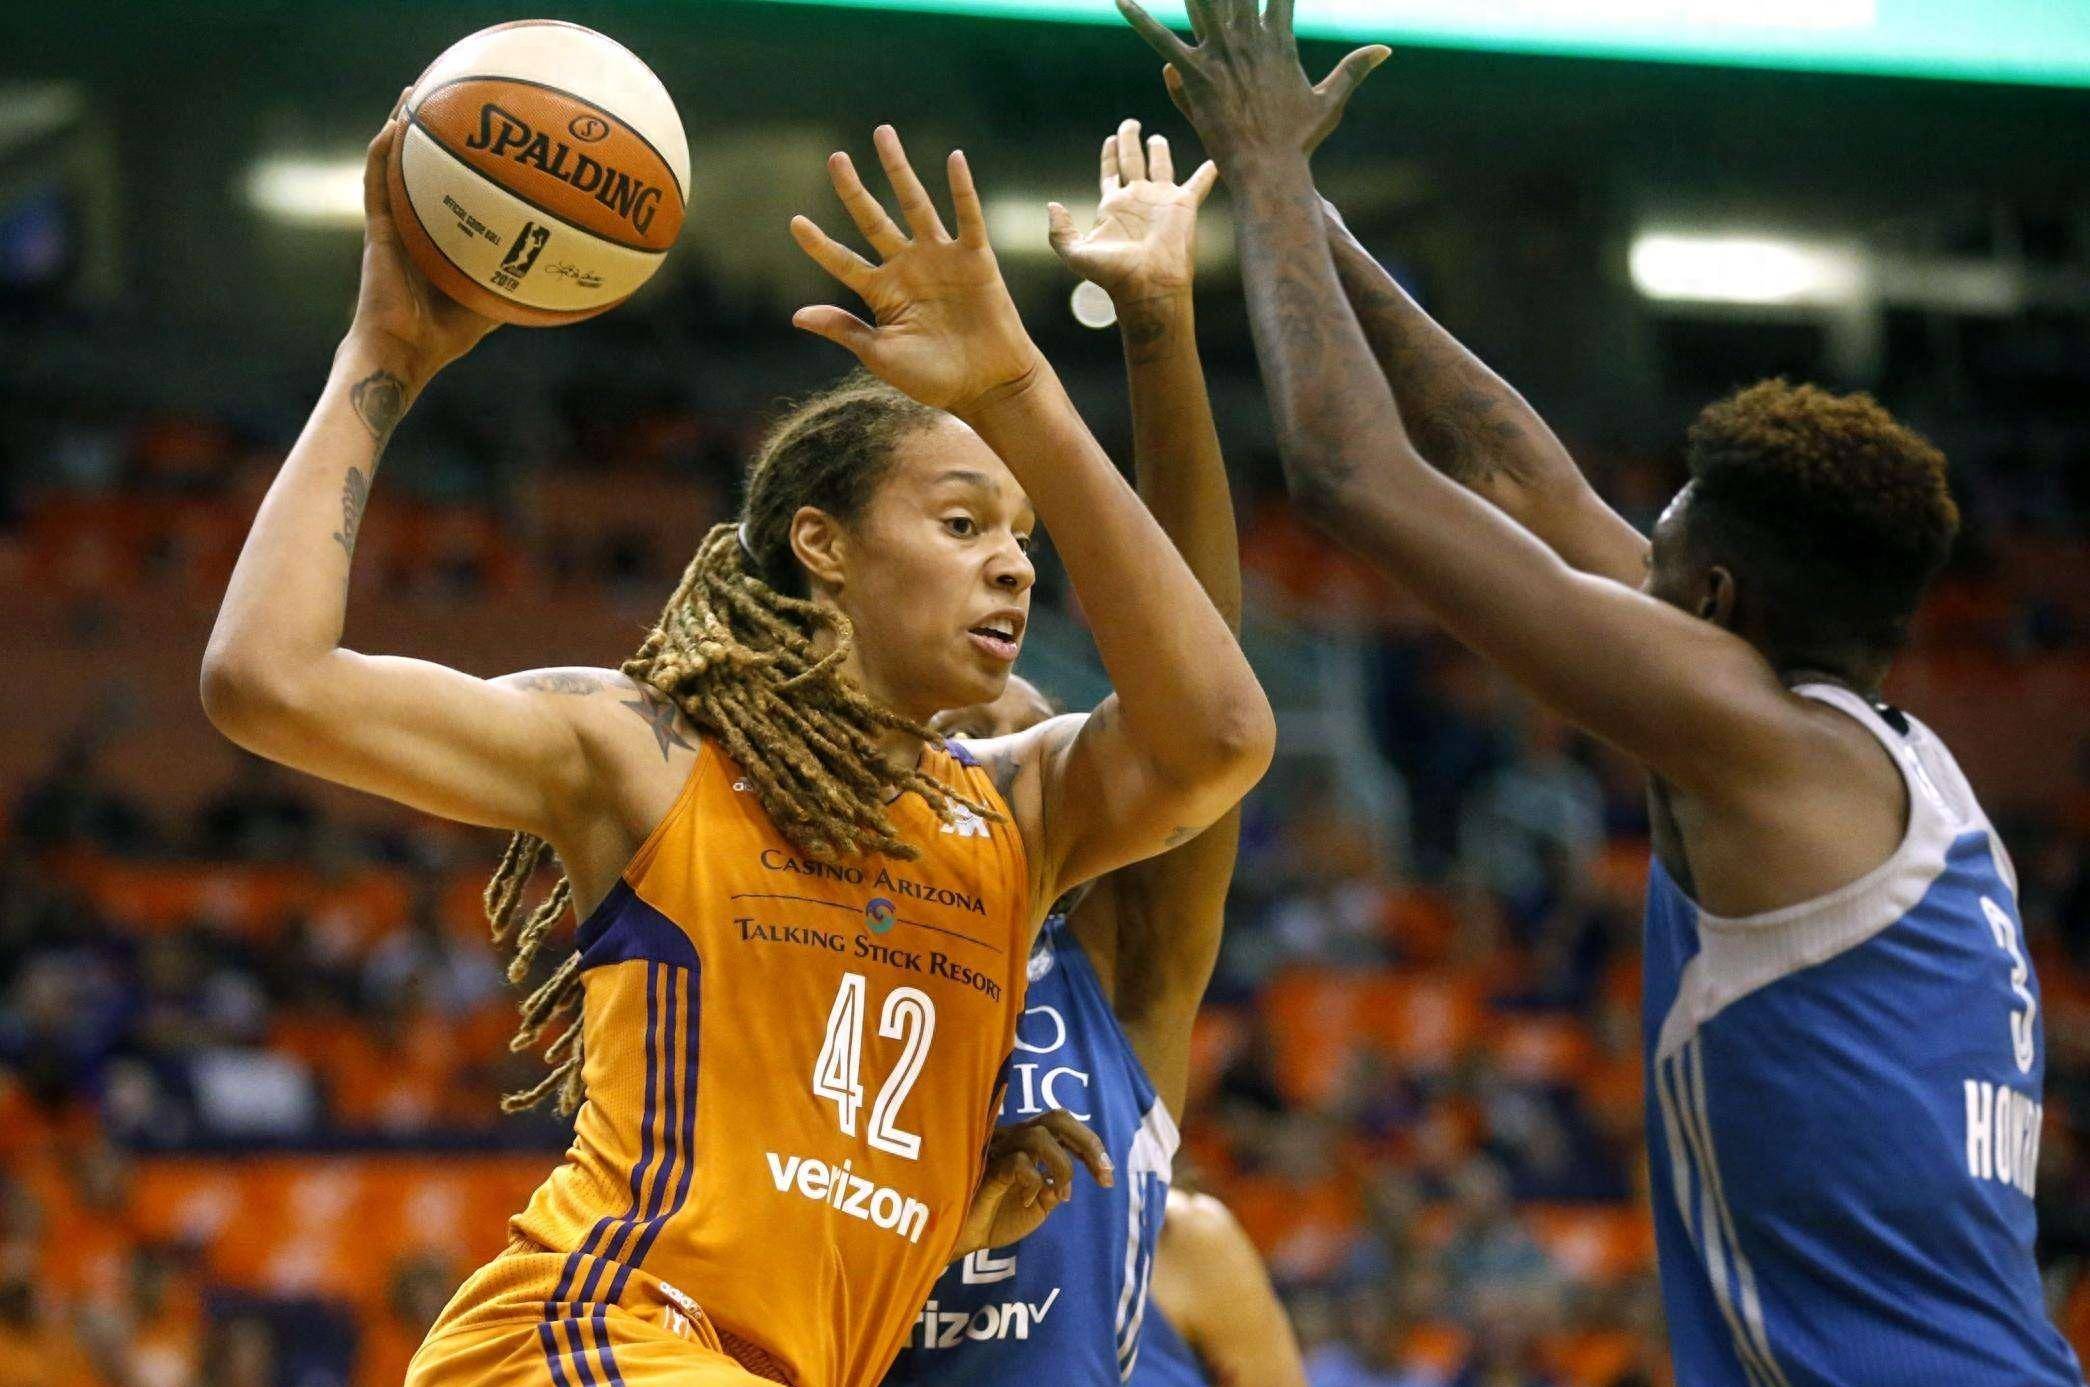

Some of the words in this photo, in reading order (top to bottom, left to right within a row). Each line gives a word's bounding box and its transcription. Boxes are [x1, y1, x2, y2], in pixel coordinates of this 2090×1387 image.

[466, 103, 663, 237] SPALDING
[761, 849, 863, 885] CASINO
[873, 869, 987, 916] ARIZONA
[733, 918, 845, 952] TALKING
[854, 934, 921, 973] STICK
[929, 952, 1002, 1003] RESORT
[1979, 896, 2037, 1074] 3
[812, 971, 937, 1161] 42
[1964, 1079, 2043, 1200] HOW
[766, 1152, 930, 1244] verizon
[900, 1300, 1030, 1350] rizon
